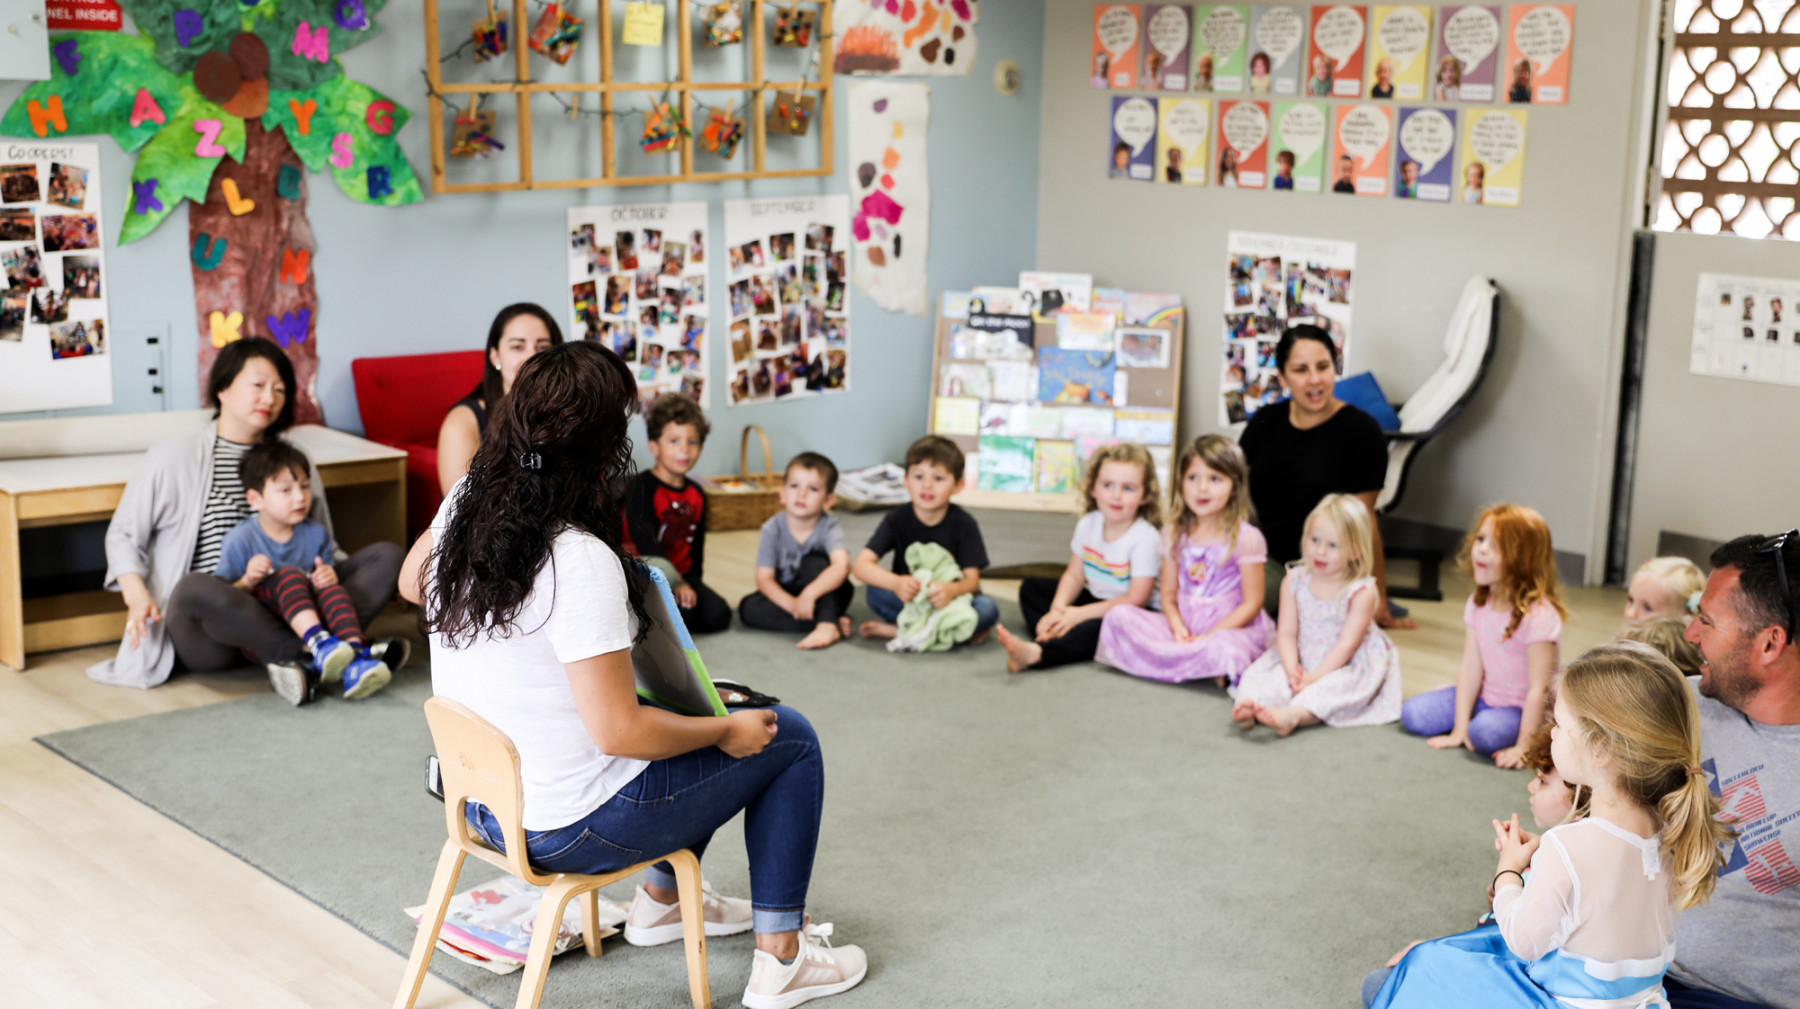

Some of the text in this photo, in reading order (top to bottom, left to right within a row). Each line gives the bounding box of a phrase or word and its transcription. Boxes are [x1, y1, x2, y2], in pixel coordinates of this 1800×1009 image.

[75, 8, 119, 22] INSIDE
[174, 10, 203, 47] P
[291, 21, 329, 63] M
[27, 94, 68, 137] H
[130, 88, 165, 127] A
[289, 98, 317, 135] Y
[366, 99, 396, 135] G
[193, 119, 226, 158] Z
[329, 132, 354, 169] S
[221, 178, 255, 216] L
[278, 163, 301, 200] B
[367, 166, 393, 199] R
[610, 206, 668, 222] OCTOBER
[192, 232, 227, 271] U
[280, 249, 309, 284] N
[210, 311, 244, 348] K
[266, 309, 310, 347] W
[1743, 829, 1781, 851] SHOWCASE
